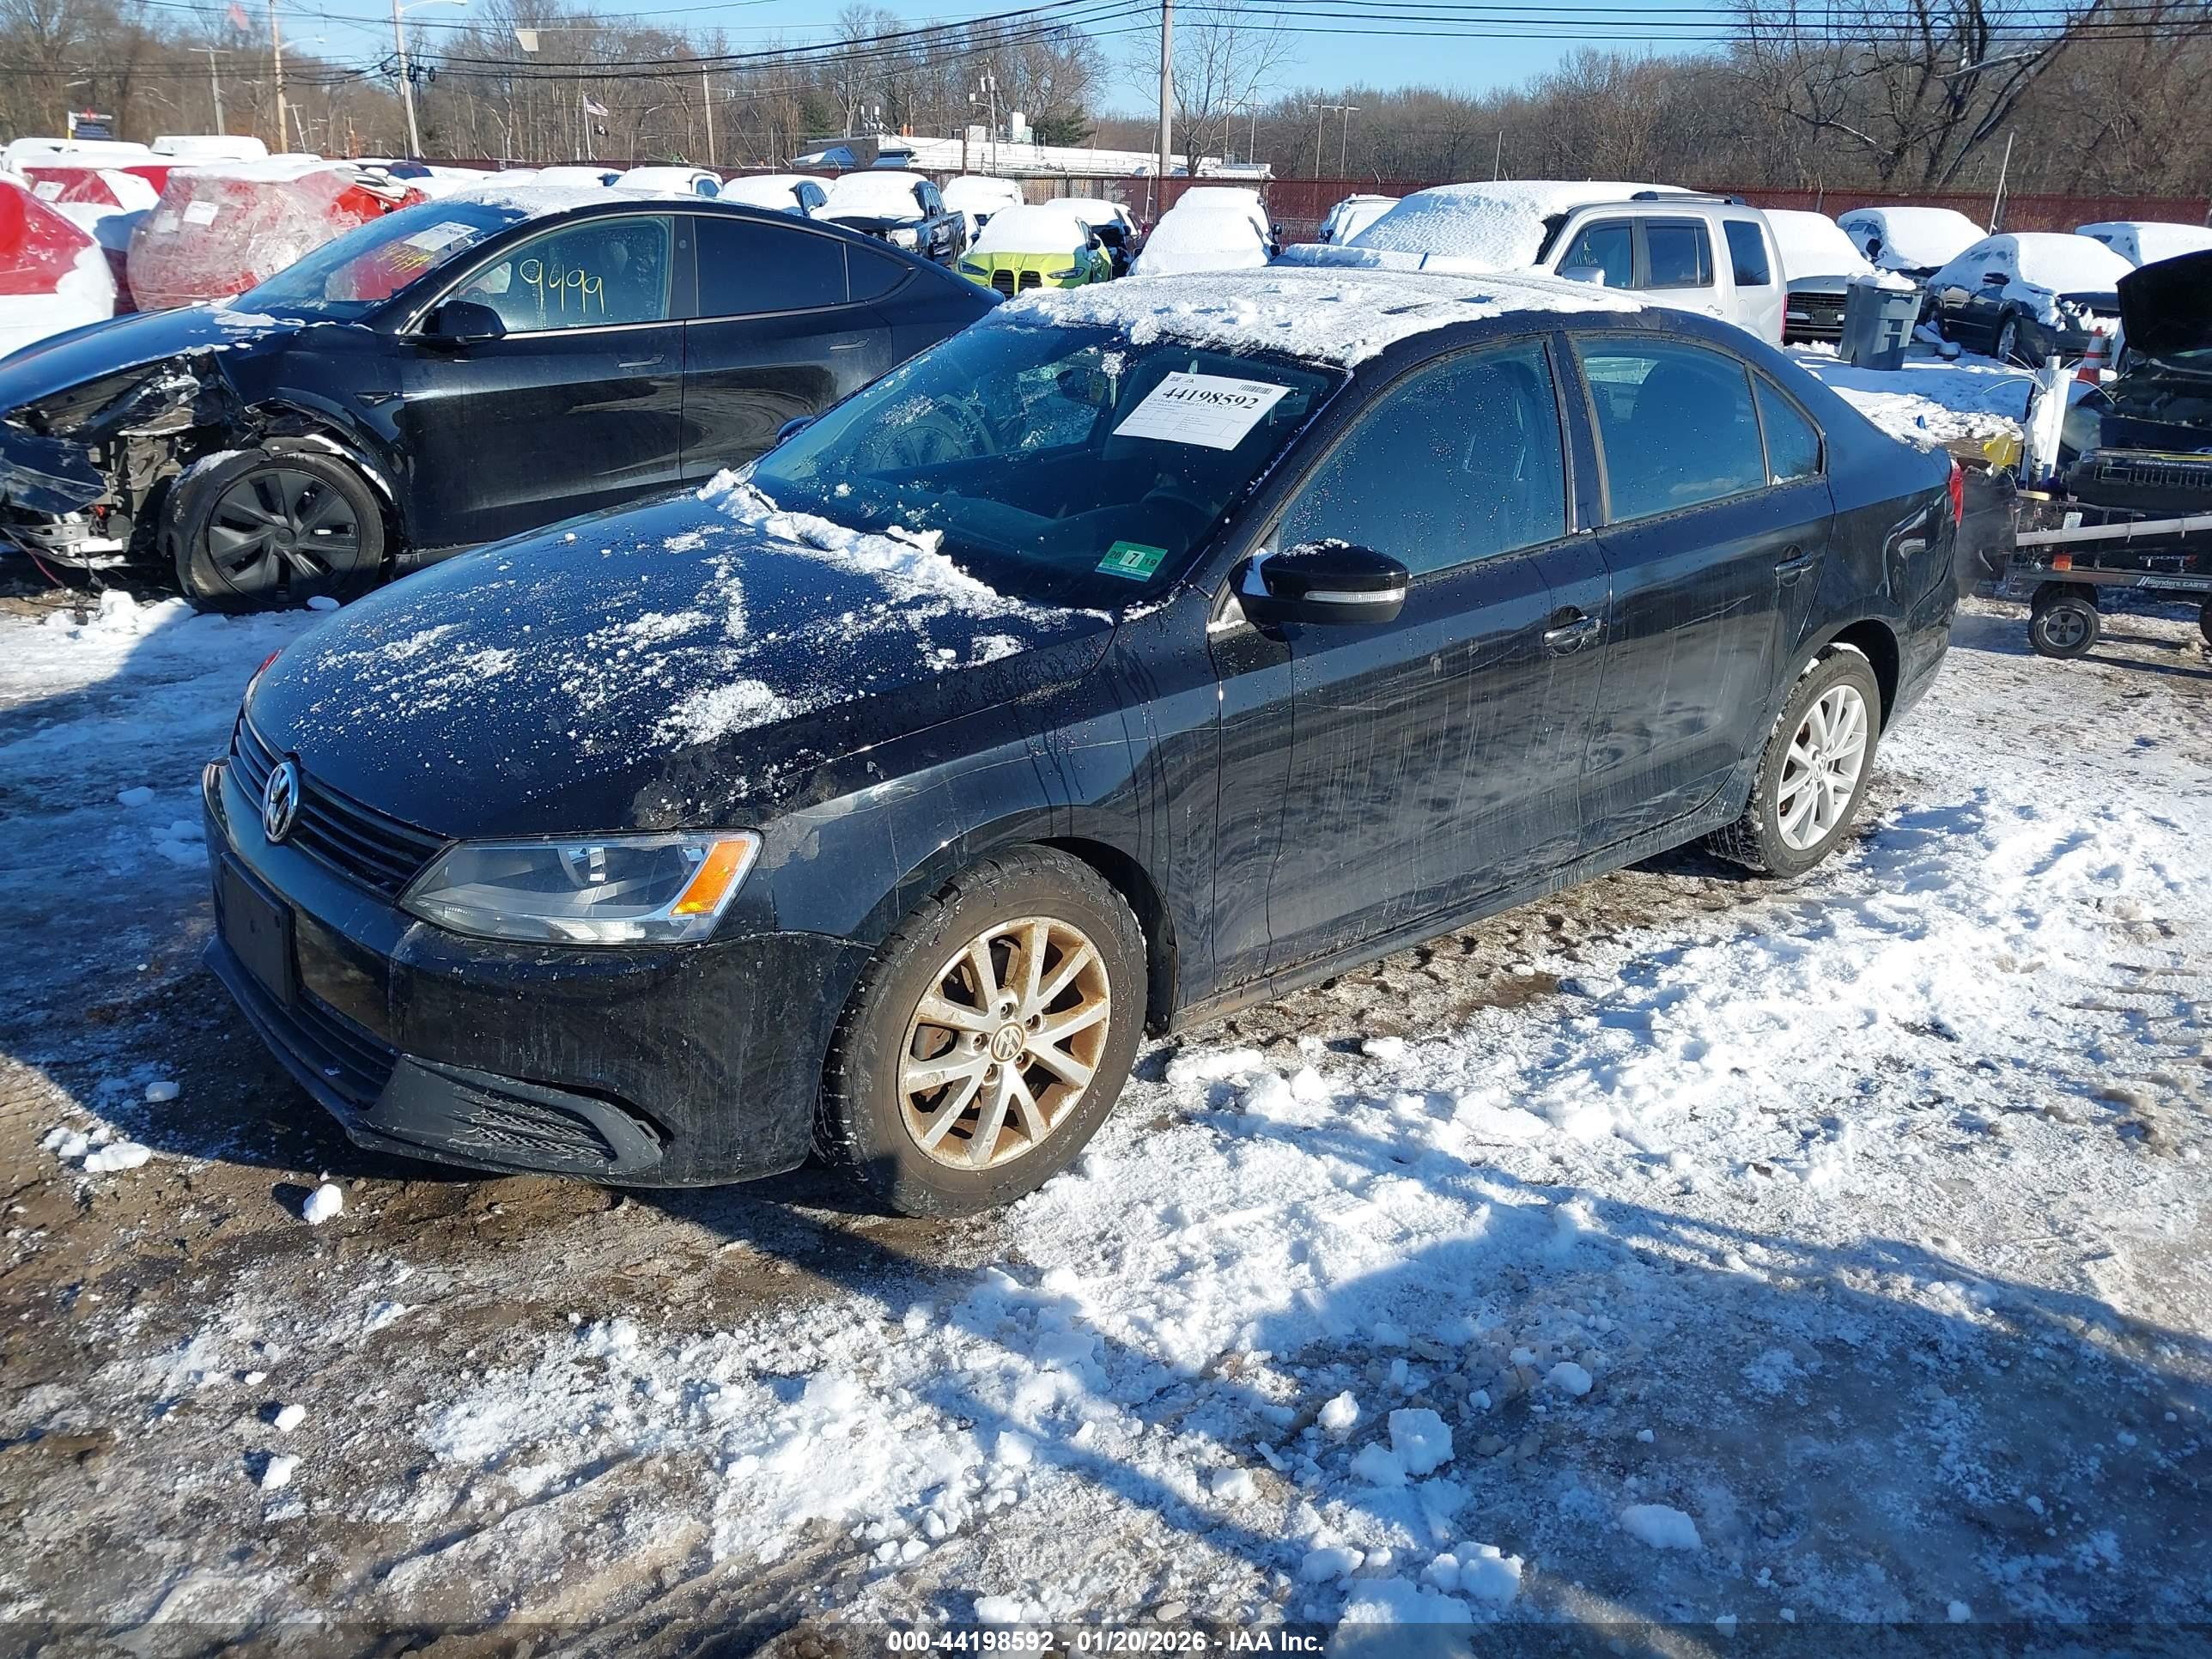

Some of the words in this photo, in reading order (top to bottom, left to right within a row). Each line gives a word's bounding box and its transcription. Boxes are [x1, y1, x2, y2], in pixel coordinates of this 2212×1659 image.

[520, 258, 605, 314] 9499
[1162, 387, 1260, 410] 44198592
[1127, 552, 1139, 565] 7
